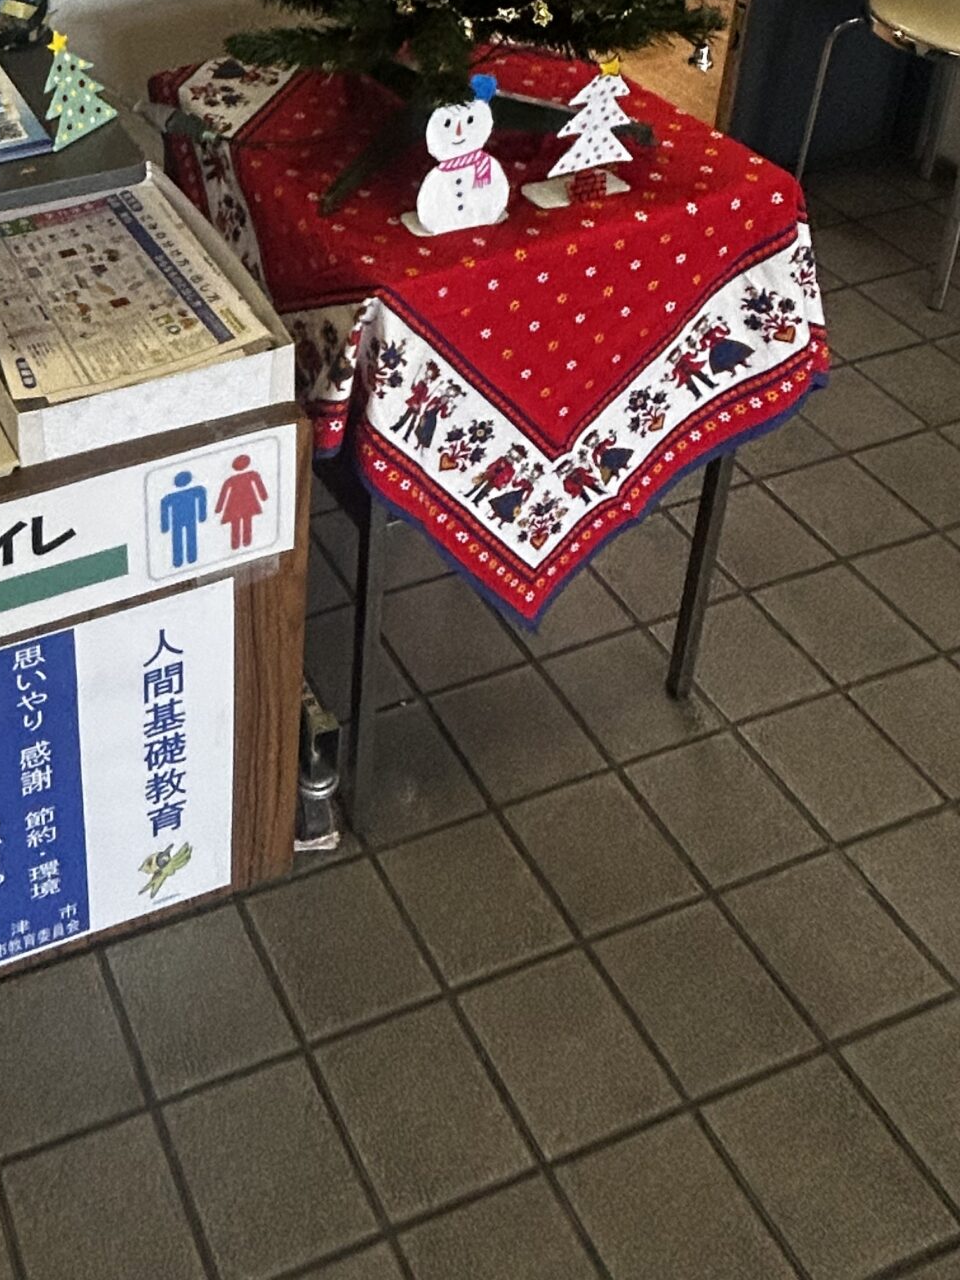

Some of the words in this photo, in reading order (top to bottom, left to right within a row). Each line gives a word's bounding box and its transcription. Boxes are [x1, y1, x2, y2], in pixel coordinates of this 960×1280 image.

[13, 645, 47, 731] 思いやり
[20, 741, 53, 797] 感謝
[143, 629, 187, 837] 人間基礎教育
